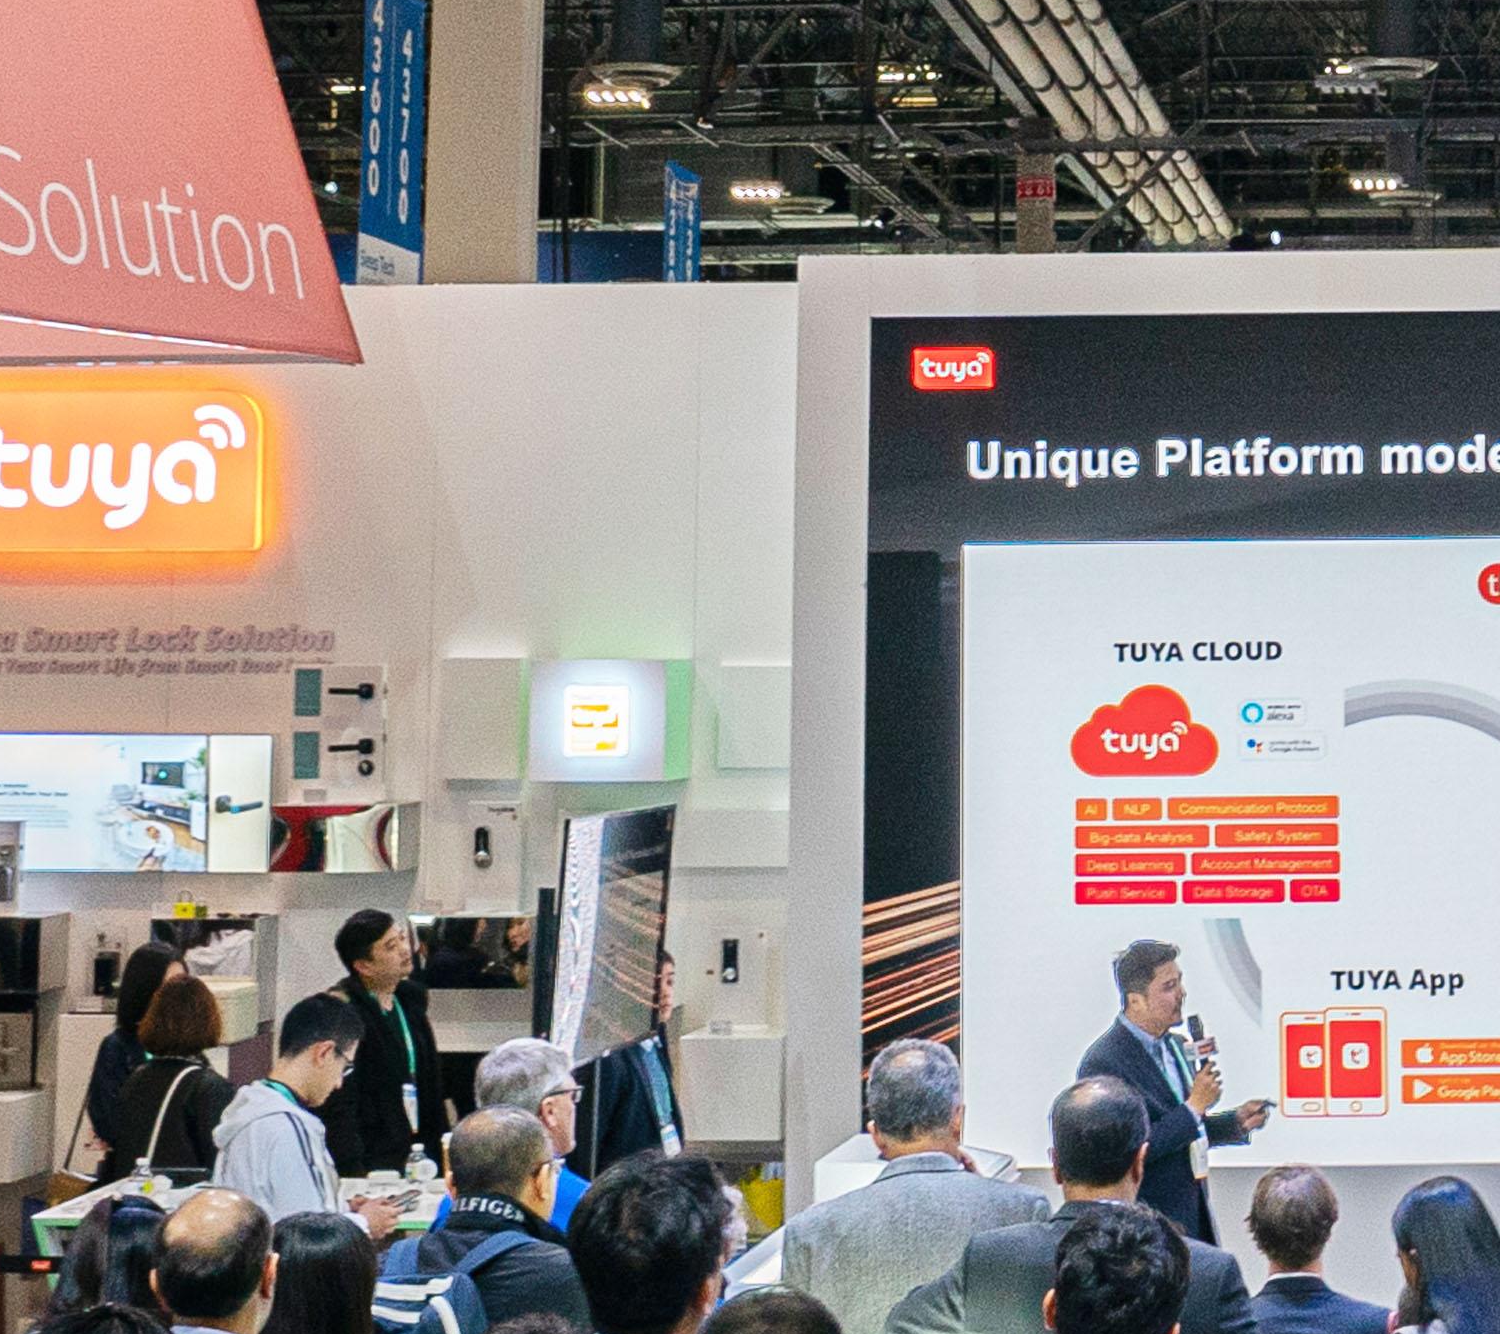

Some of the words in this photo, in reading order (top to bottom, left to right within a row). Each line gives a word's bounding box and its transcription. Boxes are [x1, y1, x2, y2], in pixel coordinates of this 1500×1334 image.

[398, 29, 413, 224] 43700
[920, 356, 981, 383] tuya
[967, 439, 1140, 487] Unique
[1156, 436, 1364, 479] Platform
[22, 626, 120, 653] Smart
[126, 624, 198, 653] Lock
[204, 623, 335, 653] Solution
[1113, 642, 1184, 663] TUYA
[1193, 641, 1282, 662] CLOUD
[1101, 727, 1180, 759] tuya
[1179, 802, 1273, 815] Communication
[1303, 885, 1327, 897] OTA
[1331, 970, 1402, 991] TUYA
[1408, 970, 1464, 995] App
[1440, 1051, 1468, 1065] App
[1437, 1085, 1480, 1100] Google
